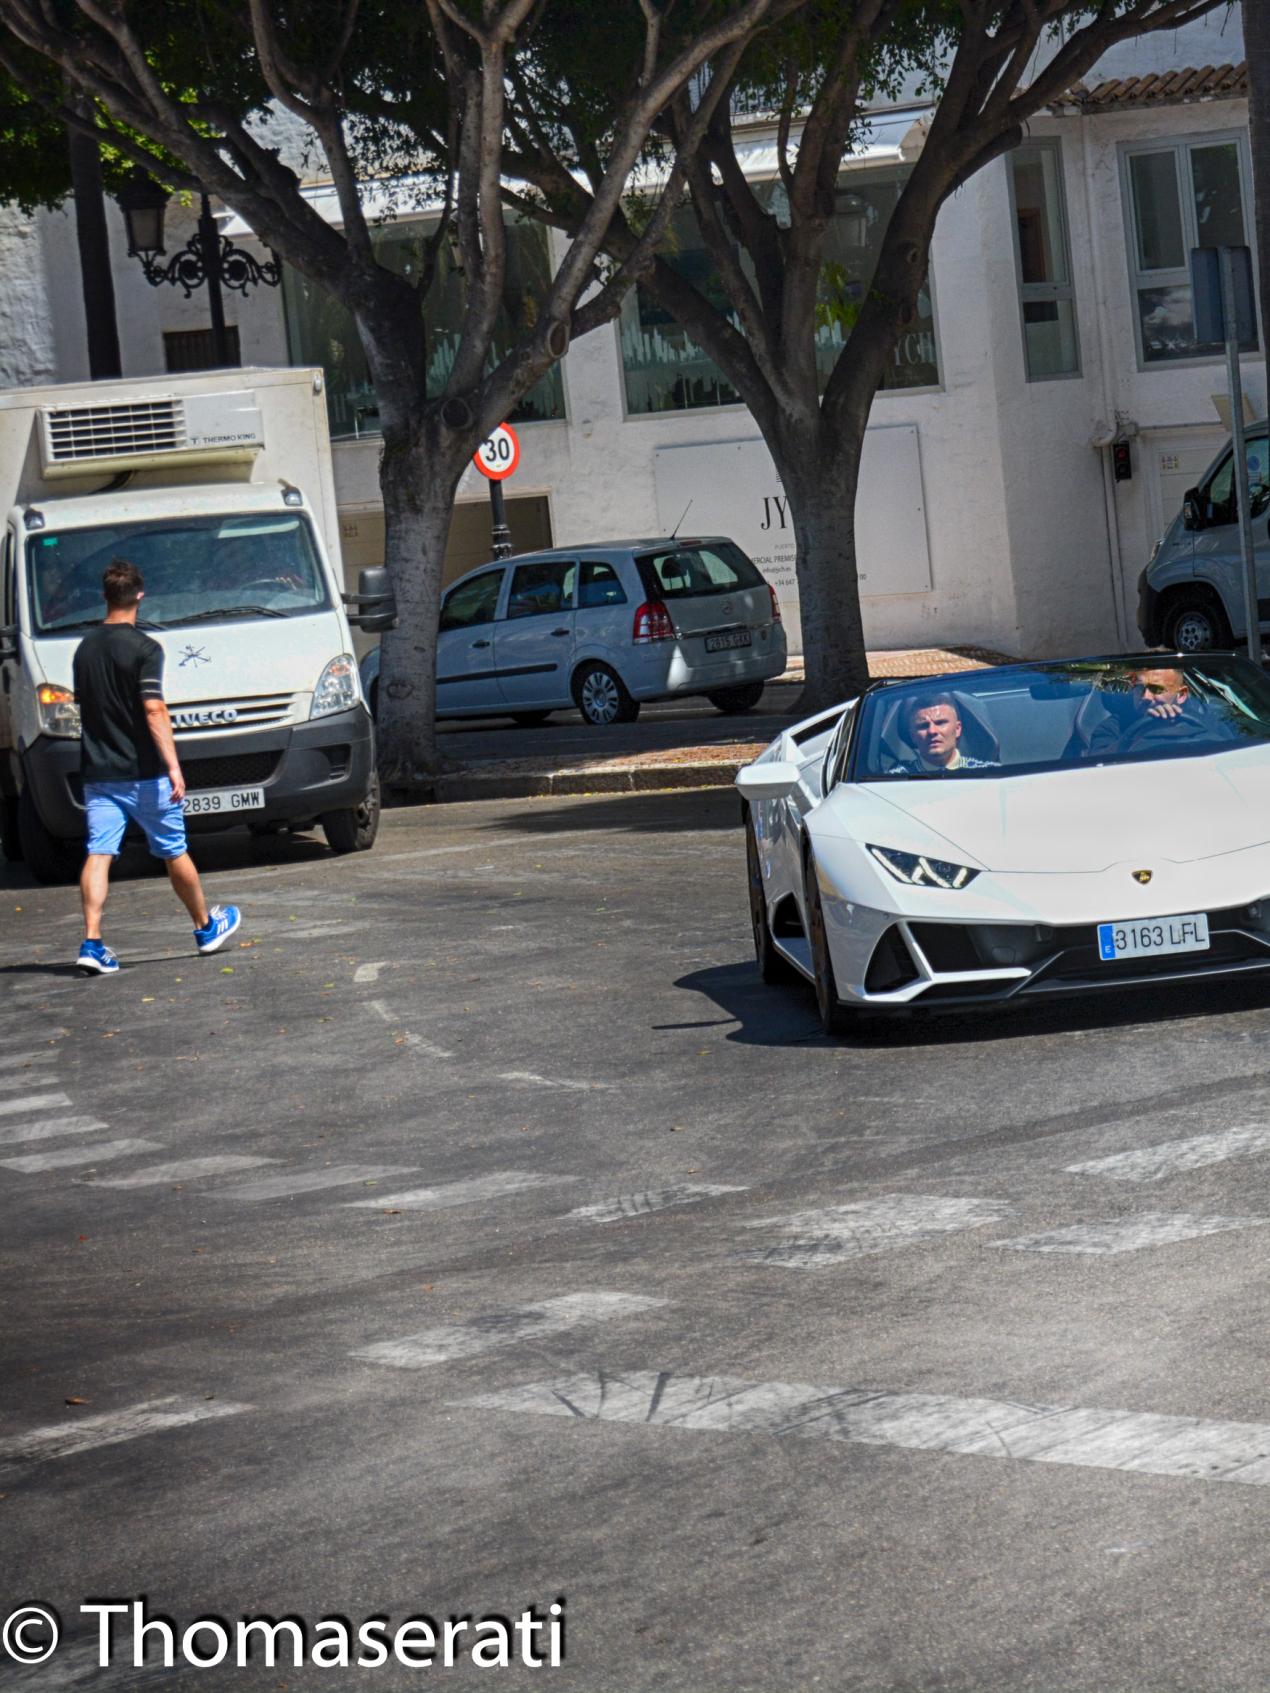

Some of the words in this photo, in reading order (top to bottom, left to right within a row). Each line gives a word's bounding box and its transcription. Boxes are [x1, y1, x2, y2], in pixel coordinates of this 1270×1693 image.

[203, 435, 236, 443] THERMO
[484, 438, 510, 462] 30
[175, 708, 238, 728] IVECO
[182, 796, 221, 814] 2839
[231, 791, 260, 808] GMW
[1104, 945, 1112, 954] E
[1115, 926, 1164, 950] 3163
[1169, 922, 1205, 945] LFL
